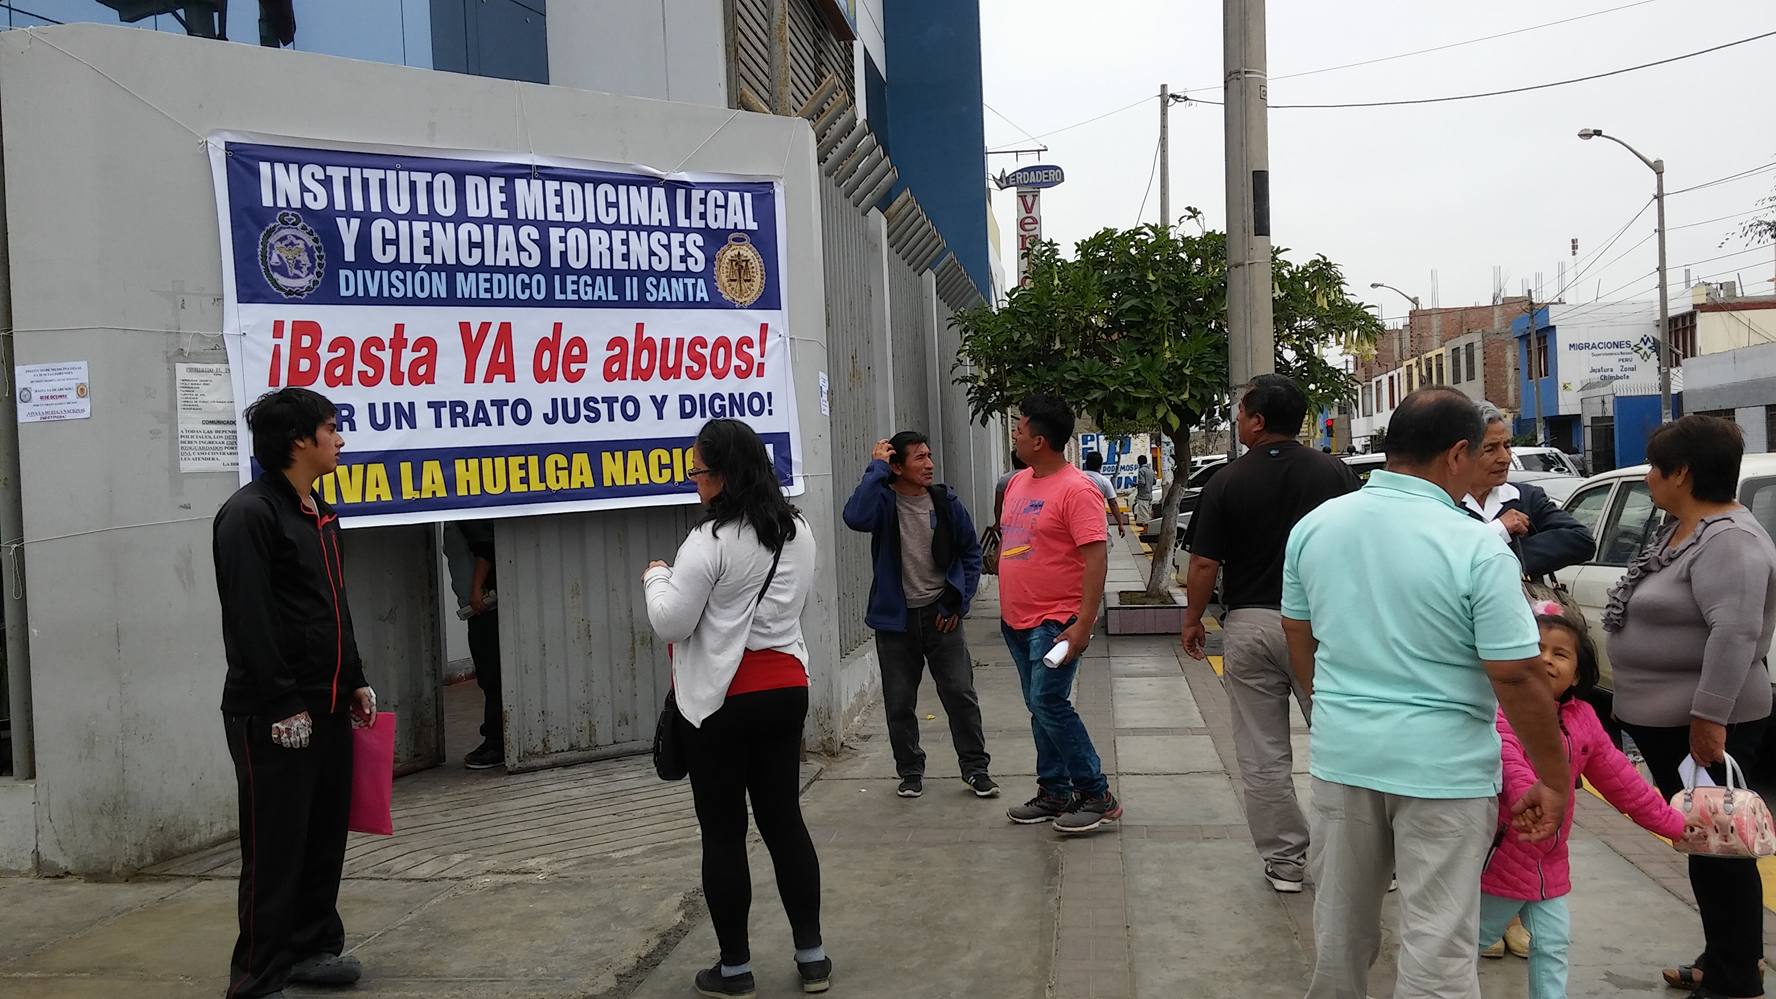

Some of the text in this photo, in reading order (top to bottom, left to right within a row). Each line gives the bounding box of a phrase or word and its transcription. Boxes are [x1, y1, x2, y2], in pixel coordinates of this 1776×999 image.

[258, 161, 759, 231] INSTITUTO DE MEDICINA LEGAL
[992, 168, 1062, 189] VERDADERO
[335, 217, 361, 262] Y
[370, 218, 542, 268] CIENCIAS
[549, 226, 706, 273] FORENSES
[338, 264, 710, 303] DIVISIÓN MEDICO LEGAL II SANTA
[268, 319, 769, 388] ¡Basta YA de abusos!
[1568, 340, 1631, 350] MIGRACIONES
[368, 402, 417, 431] UN
[427, 398, 533, 429] TRATO
[542, 394, 641, 425] JUSTO
[650, 394, 669, 420] Y
[678, 391, 774, 420] DIGNO!
[399, 459, 448, 500] LA
[454, 453, 595, 497] HUELGA
